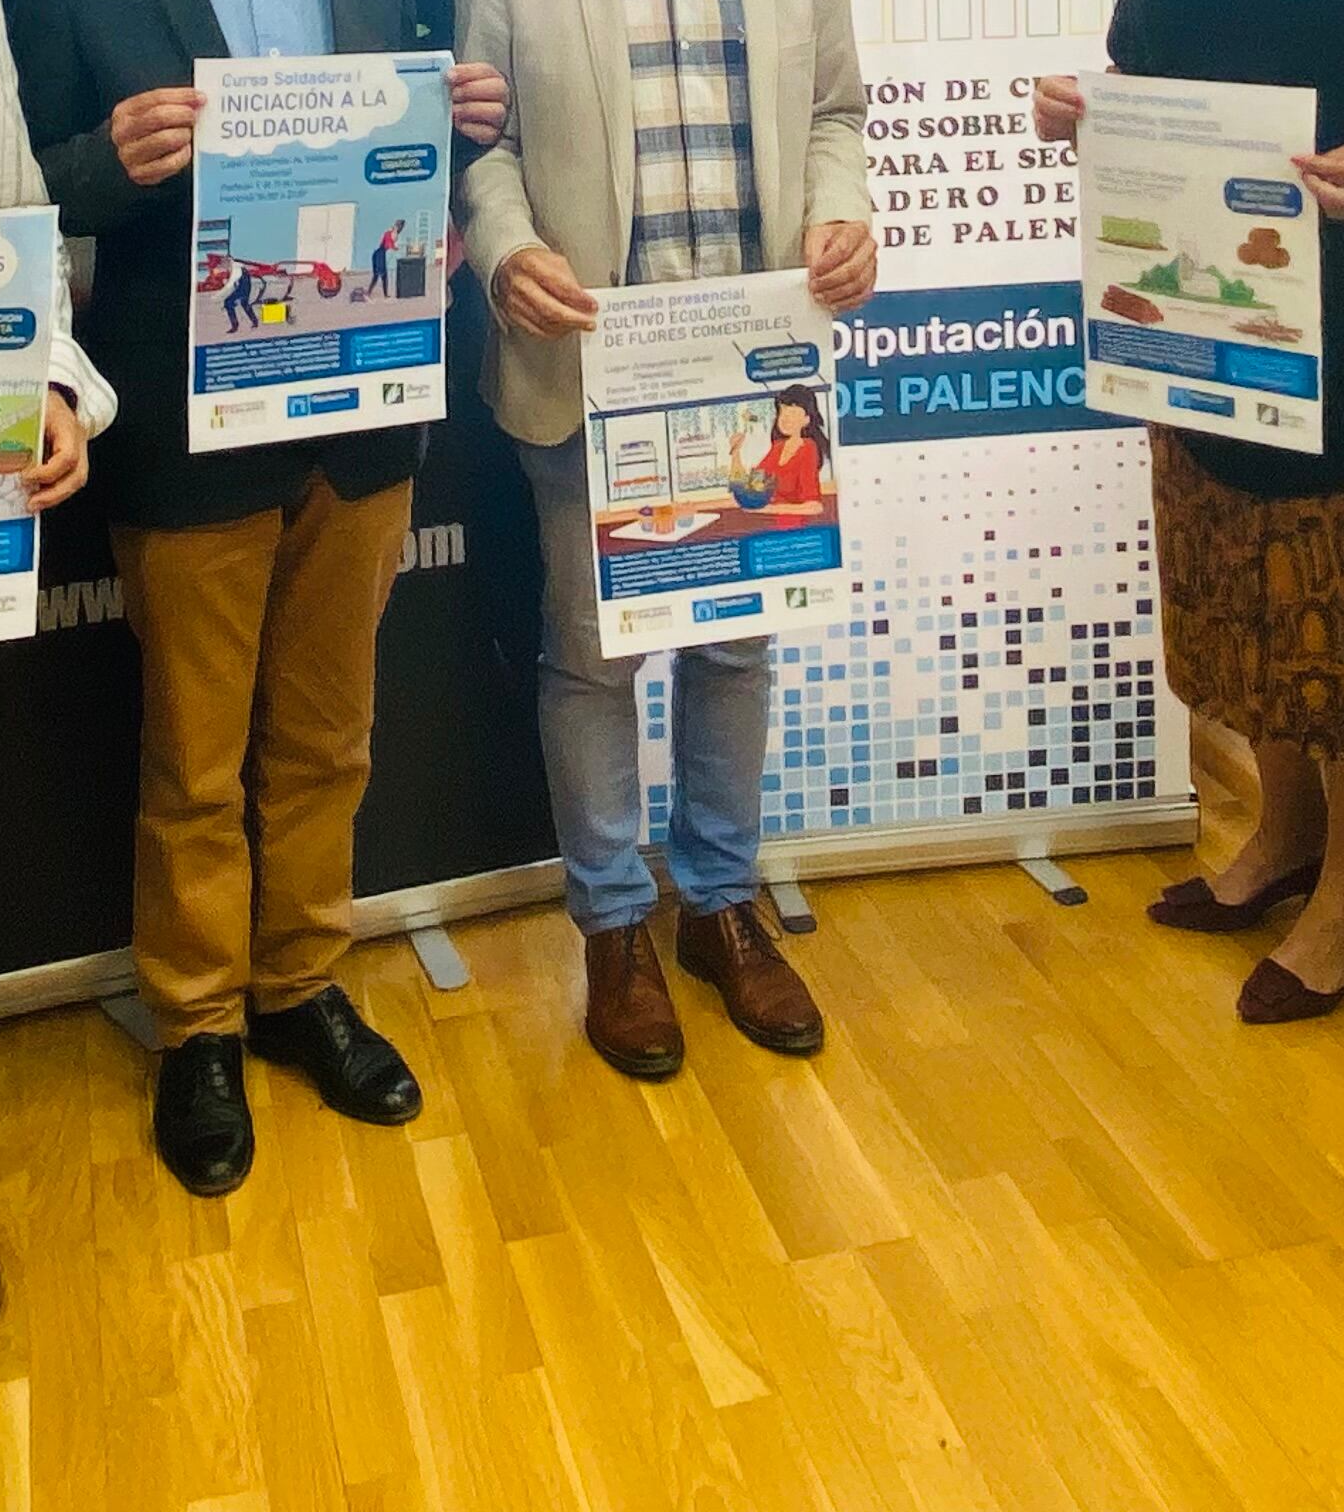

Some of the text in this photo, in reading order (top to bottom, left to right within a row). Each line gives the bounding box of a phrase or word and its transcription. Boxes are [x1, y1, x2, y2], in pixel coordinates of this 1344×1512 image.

[220, 87, 387, 114] INICIACIÓN A LA
[945, 78, 991, 101] DE
[1009, 76, 1042, 98] C
[220, 115, 349, 140] SOLDADURA
[918, 112, 1027, 139] SOBRE
[964, 149, 1005, 172] EL
[1023, 182, 1075, 205] DE
[883, 216, 1078, 249] DE PALEN
[605, 287, 746, 314] Jornada presencial
[603, 311, 664, 332] CULTIVO
[604, 314, 792, 349] DE FLORES COMESTIBLES
[899, 365, 1087, 415] PALENC
